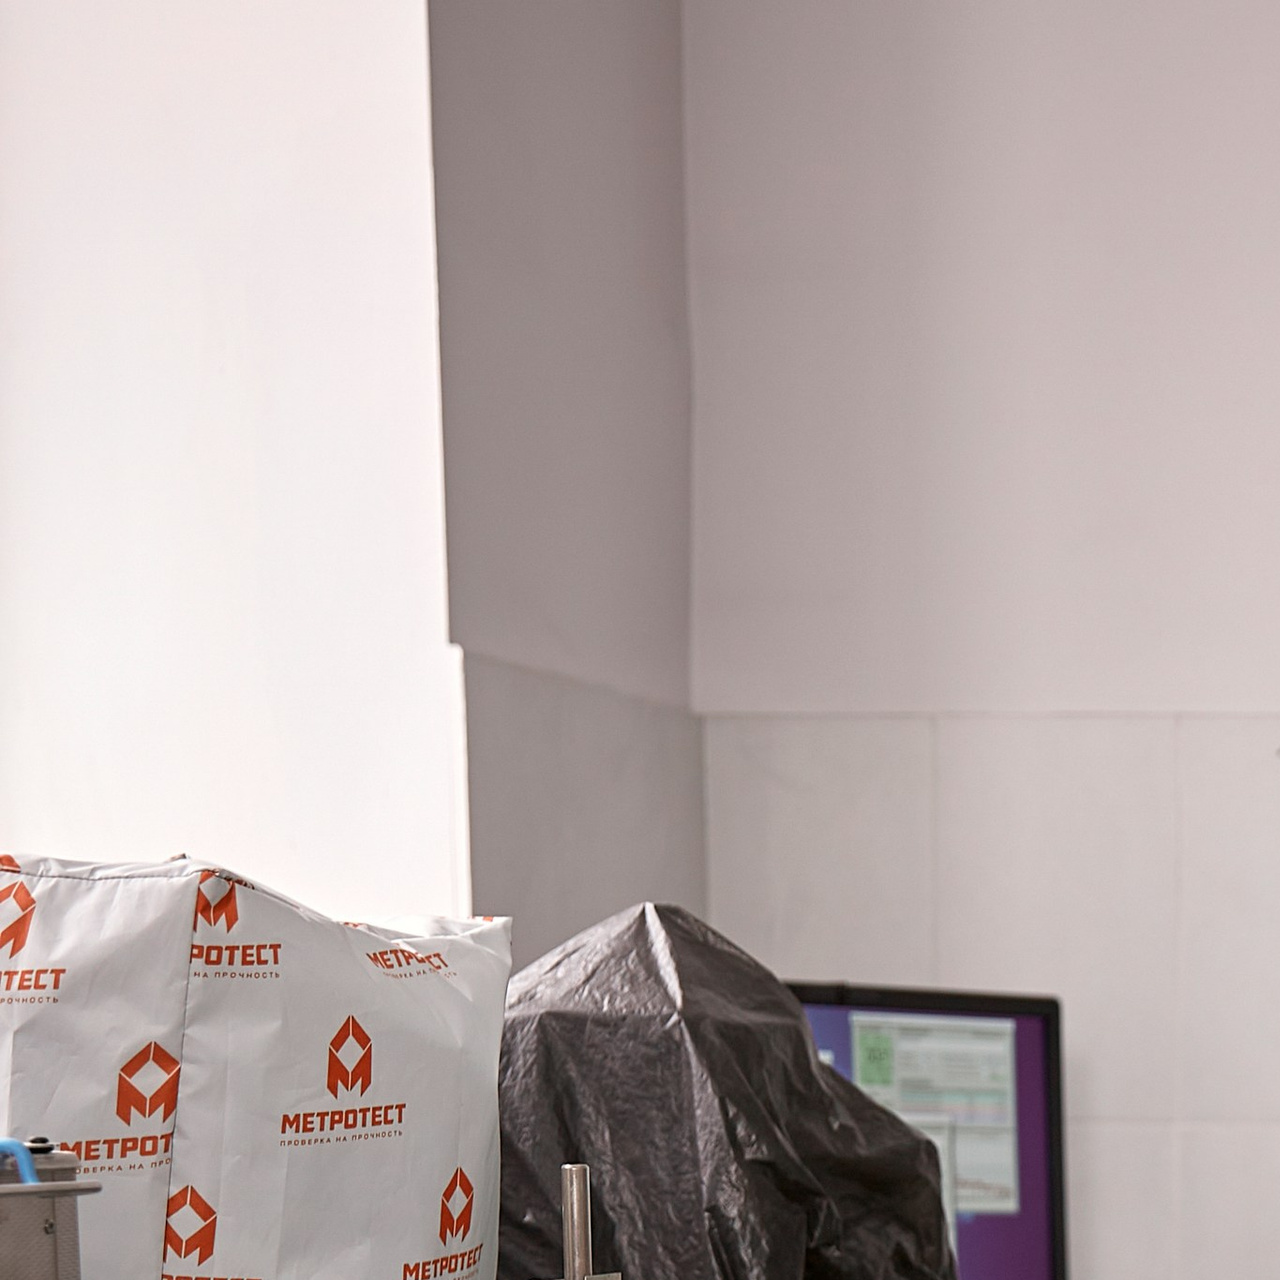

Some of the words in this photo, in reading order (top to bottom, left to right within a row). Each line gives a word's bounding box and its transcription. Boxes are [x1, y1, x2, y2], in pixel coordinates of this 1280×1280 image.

[0, 968, 66, 991] ТЕСТ
[193, 971, 209, 979] НА
[214, 970, 281, 980] ПРОЧНОСТЬ
[281, 1103, 407, 1134] МЕТРОТЕСТ
[280, 1137, 332, 1147] ПРОВЕРКА
[335, 1135, 348, 1143] НА
[351, 1130, 404, 1142] ПРОЧНОСТЬ
[129, 1162, 144, 1170] НА
